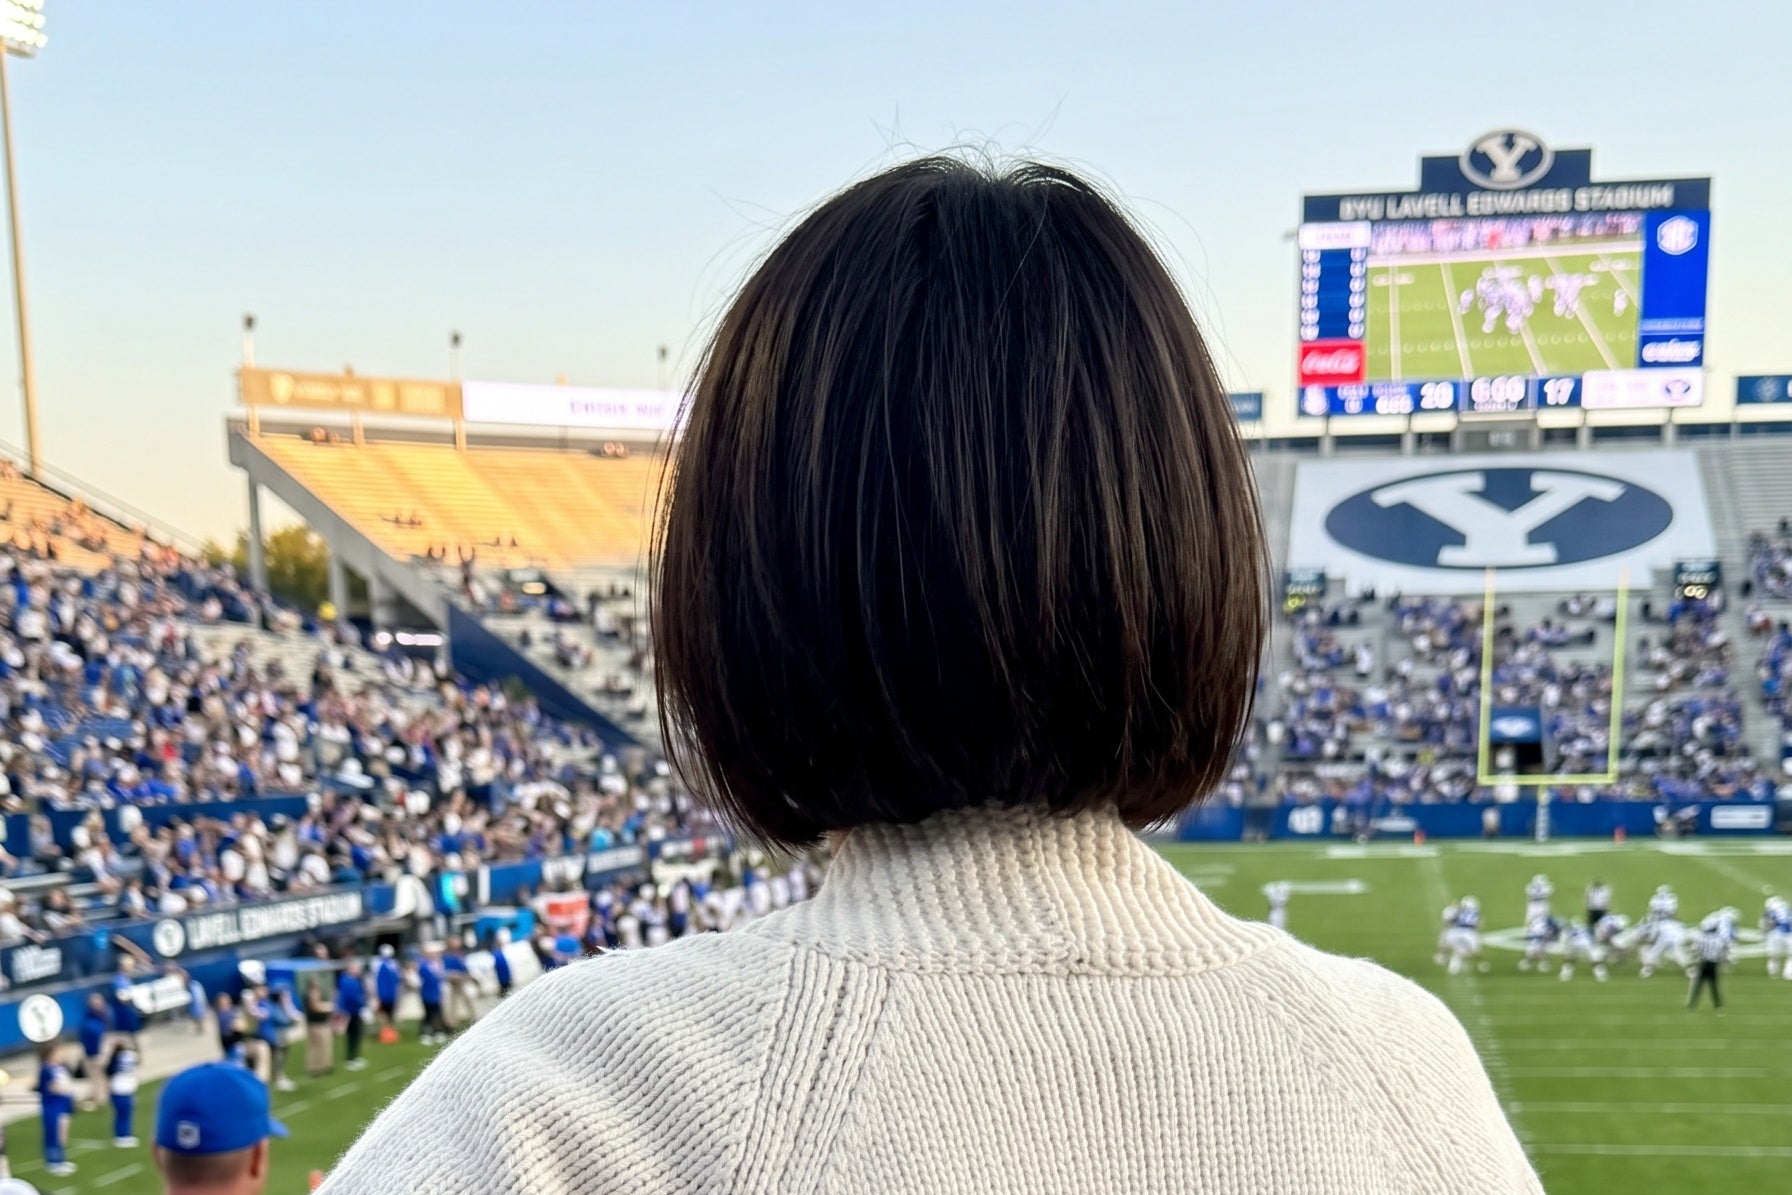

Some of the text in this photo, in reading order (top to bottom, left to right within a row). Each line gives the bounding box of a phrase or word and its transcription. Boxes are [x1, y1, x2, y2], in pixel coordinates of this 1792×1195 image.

[1475, 133, 1538, 181] Y
[1339, 184, 1674, 220] BYU LAVELL EDWARDS STADIUM
[1543, 378, 1574, 405] 17
[1371, 471, 1627, 565] Y
